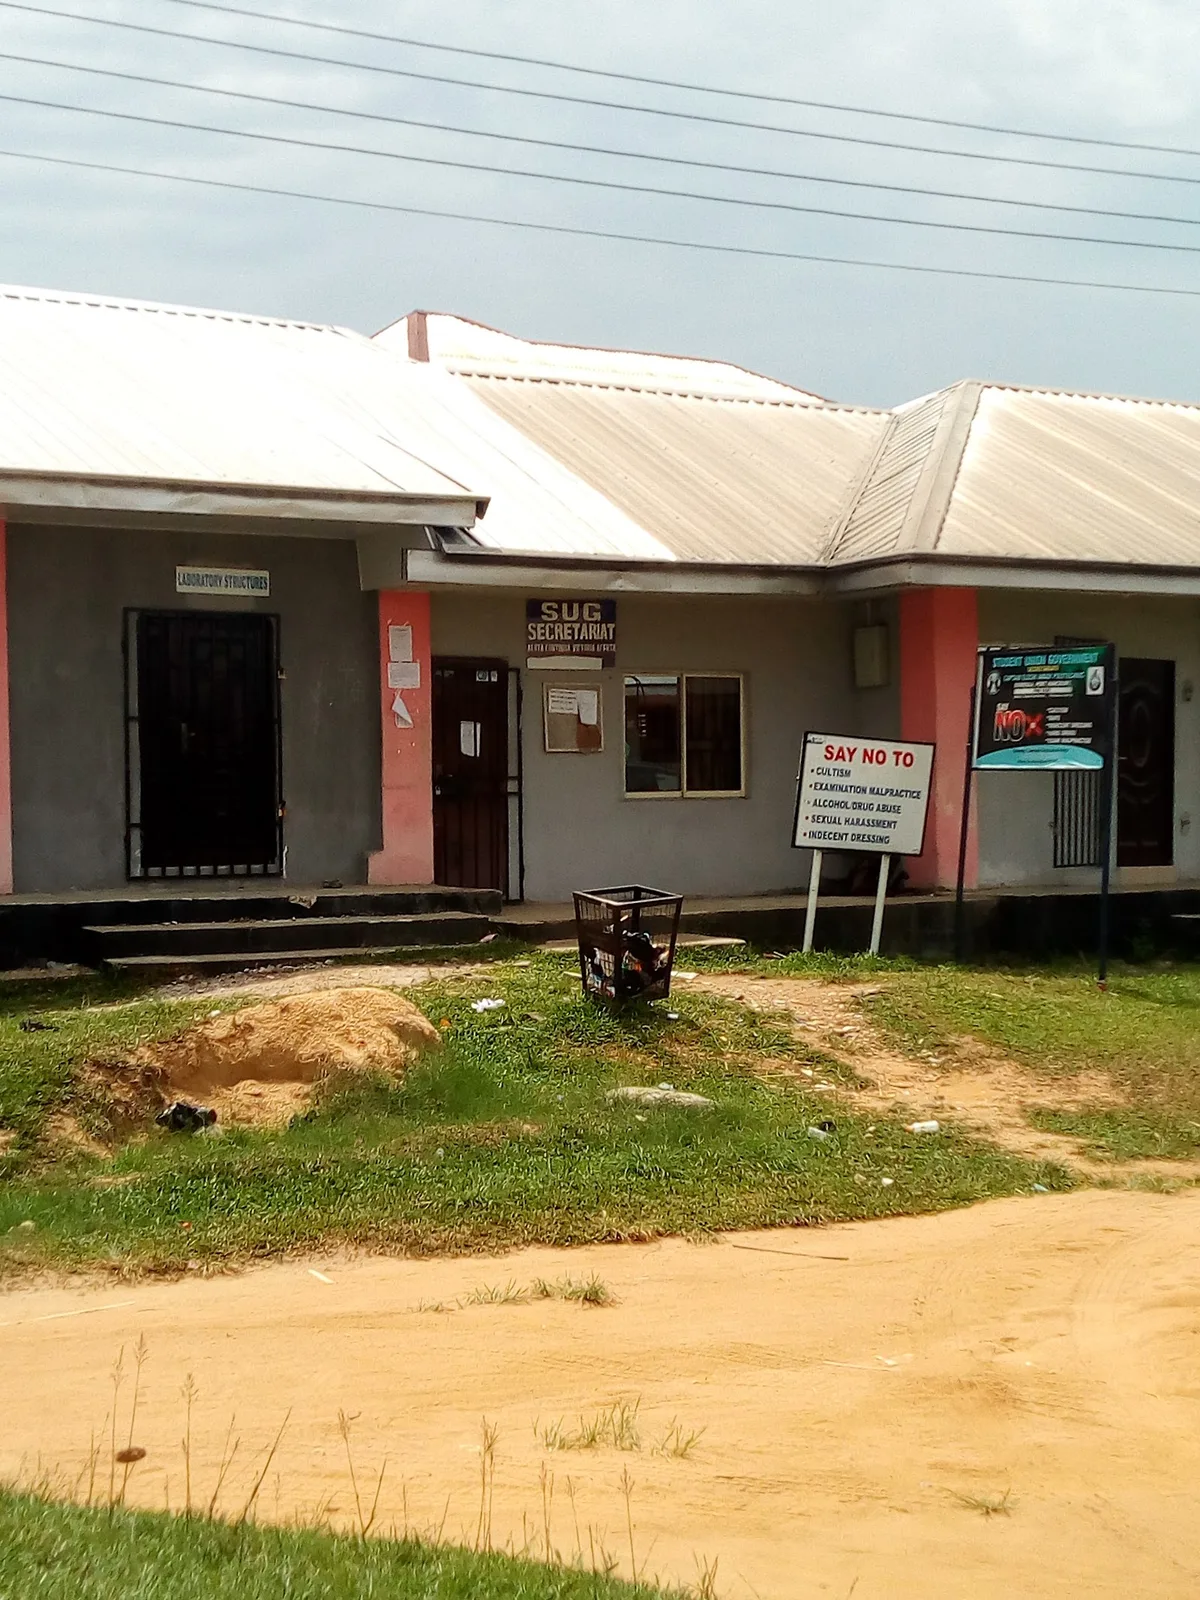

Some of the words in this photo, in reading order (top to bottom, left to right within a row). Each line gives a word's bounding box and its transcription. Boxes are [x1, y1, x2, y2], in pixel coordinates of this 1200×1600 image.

[224, 574, 268, 590] STRUCTURES
[541, 602, 602, 621] SUG
[527, 622, 616, 641] SECRETARIAT
[993, 710, 1027, 742] NO
[824, 745, 857, 763] SAY
[862, 748, 887, 766] NO
[893, 751, 914, 768] TO
[816, 767, 852, 778] CULTISM
[813, 782, 867, 795] EXAMINATION
[868, 786, 922, 800] MALPRACTICE
[876, 803, 902, 815] ABUSE
[811, 814, 842, 826] SEXUAL
[844, 817, 898, 830] HARASSMENT
[808, 831, 849, 842] INDECENT
[850, 832, 890, 845] DRESSING
